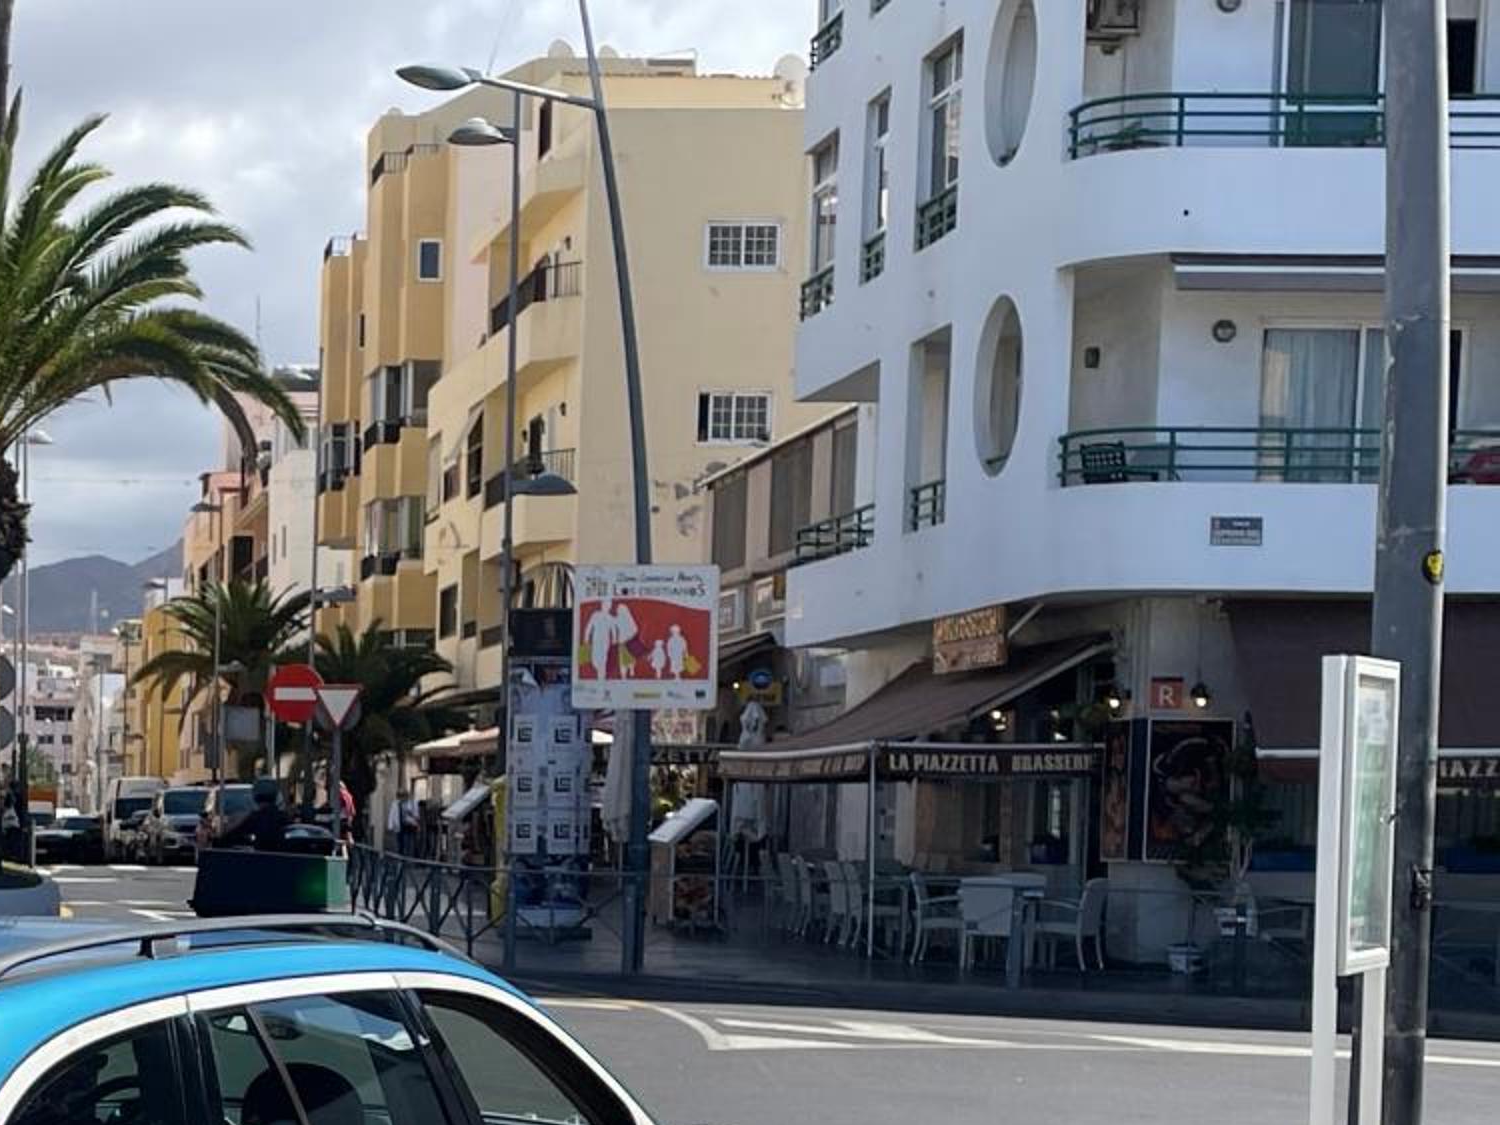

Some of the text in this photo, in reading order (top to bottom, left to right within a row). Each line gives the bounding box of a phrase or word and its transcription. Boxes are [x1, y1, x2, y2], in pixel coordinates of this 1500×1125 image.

[1158, 685, 1175, 706] R
[889, 754, 909, 771] LA
[913, 754, 999, 773] PIAZZETTA
[1440, 760, 1500, 778] IAZZ
